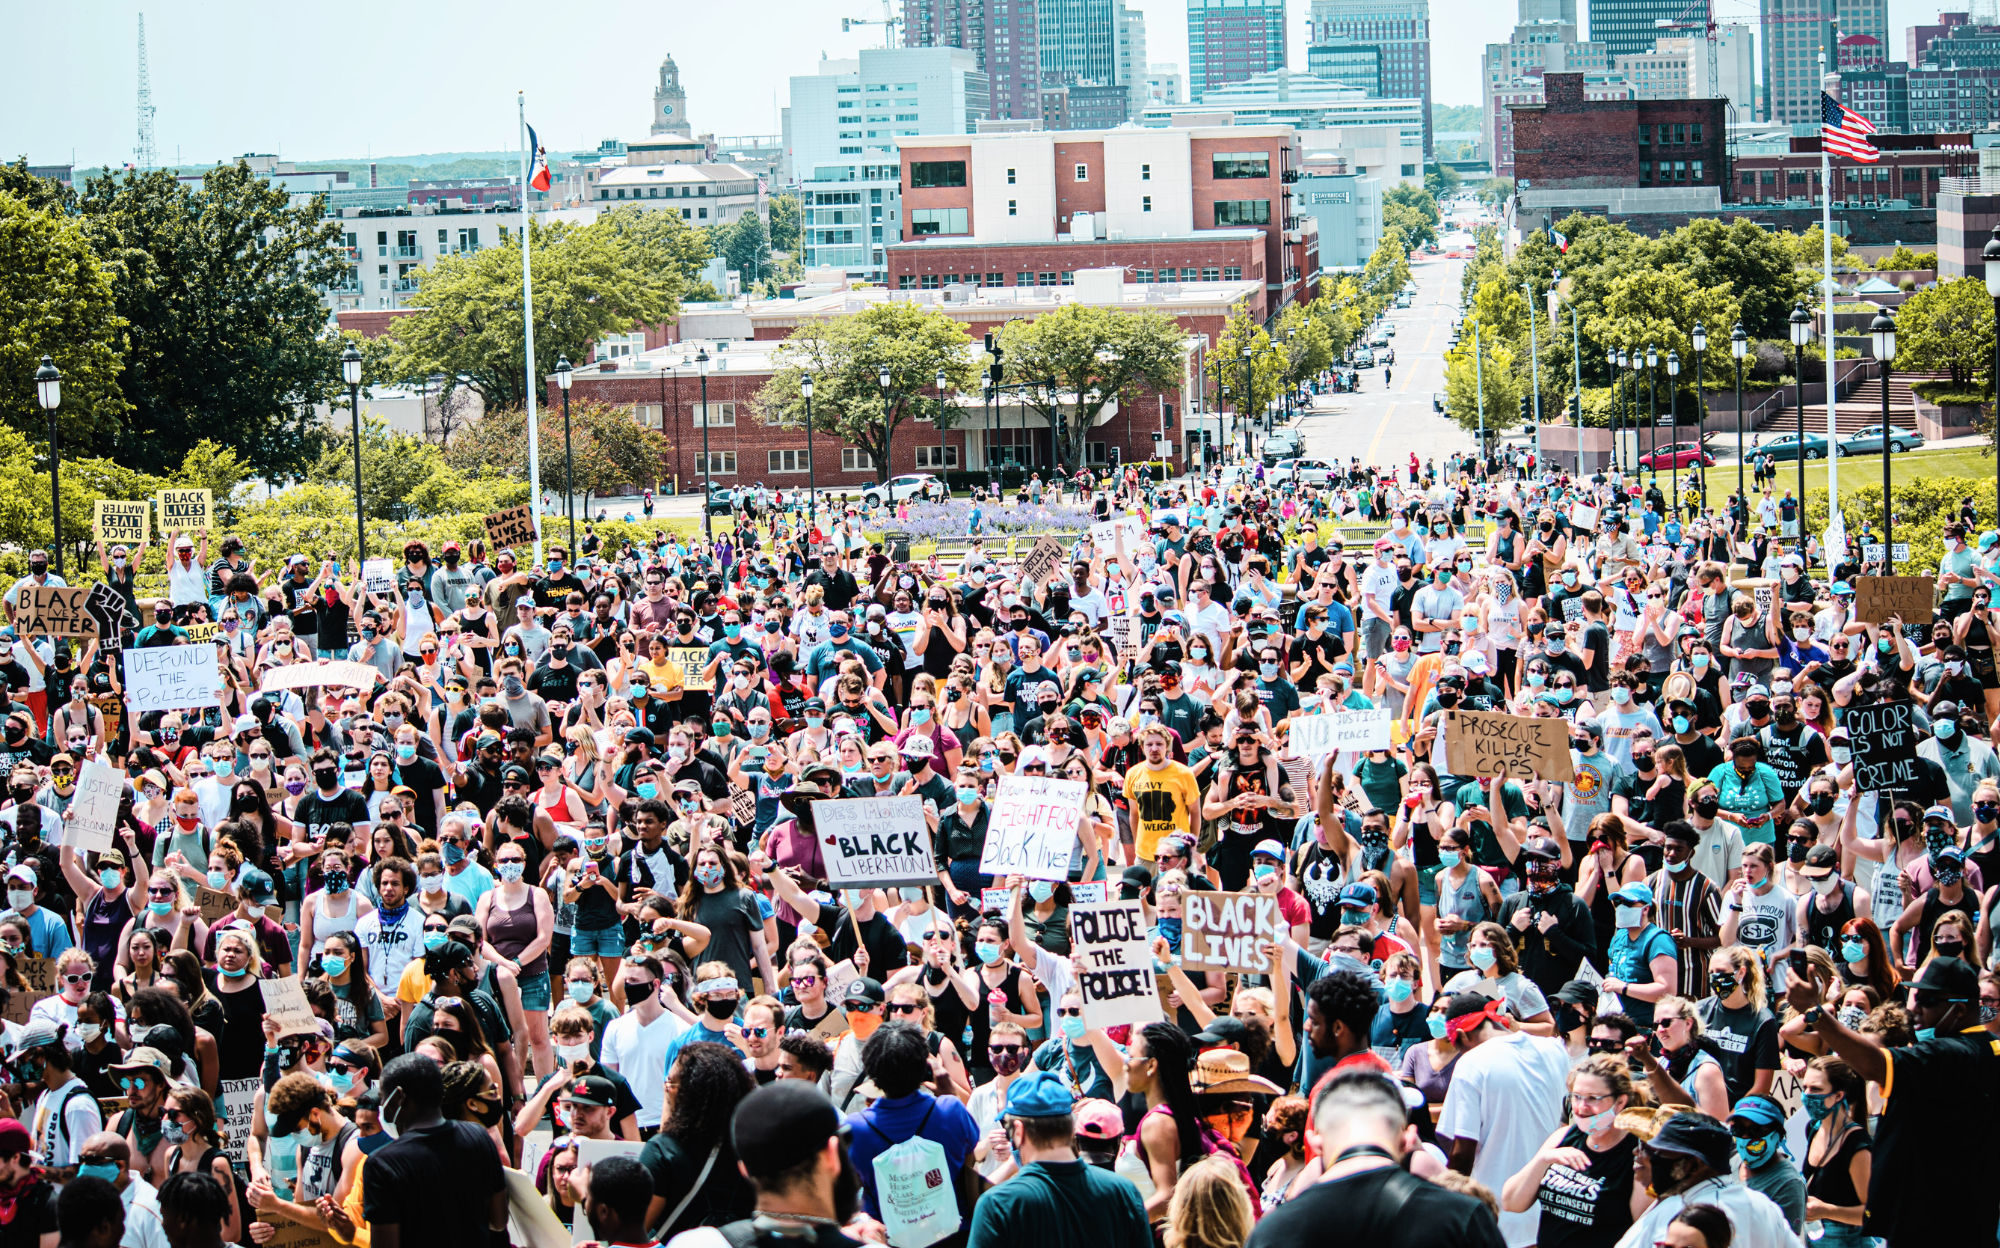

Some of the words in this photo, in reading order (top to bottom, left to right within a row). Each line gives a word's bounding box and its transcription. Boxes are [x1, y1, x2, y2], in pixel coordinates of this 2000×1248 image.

[164, 492, 204, 503] BLACK
[103, 504, 145, 514] MATTER
[165, 504, 205, 516] LIVES
[103, 515, 141, 526] LIVES
[163, 517, 205, 527] MATTER
[485, 509, 526, 529] BLACK
[102, 527, 142, 539] BLACK
[490, 521, 526, 540] LIVES
[1097, 525, 1135, 541] #BM
[493, 531, 538, 549] MATTER
[1880, 545, 1906, 553] JTICE
[1872, 578, 1922, 596] BLACK
[19, 591, 82, 609] BLAC
[1869, 595, 1915, 609] LIVES
[37, 608, 79, 618] LIVES
[1866, 608, 1926, 623] MATTER
[17, 617, 95, 634] MATTER
[188, 626, 217, 639] BLAC
[1113, 619, 1130, 631] BLACK
[133, 648, 209, 673] DEFUND
[671, 651, 707, 662] LACK
[157, 672, 187, 685] THE
[266, 671, 278, 687] I
[138, 687, 209, 706] POLICE
[1847, 704, 1910, 736] COLOR
[1296, 716, 1330, 752] NO
[1336, 710, 1383, 726] JUSTICE
[1338, 729, 1369, 741] PEACE
[1460, 714, 1551, 746] PROSECUTE
[1606, 727, 1632, 736] CYCLO
[1475, 739, 1542, 758] KILLER
[1849, 735, 1871, 755] IS
[1882, 730, 1906, 749] NOT
[1477, 756, 1533, 775] COPS
[1854, 755, 1867, 770] A
[1780, 777, 1807, 788] mond
[1857, 759, 1919, 792] CRIME
[999, 780, 1025, 797] Brown
[1031, 782, 1050, 797] folk
[1057, 789, 1084, 802] must
[1133, 782, 1164, 791] HEAVY
[84, 795, 96, 816] 4
[819, 802, 856, 822] DES
[68, 813, 114, 834] BREONNA
[1000, 802, 1045, 828] FIGHT
[1047, 805, 1078, 830] FOR
[843, 821, 895, 834] DEMANDS
[1144, 822, 1176, 831] WEIGHT
[839, 830, 923, 858] BLACK
[1036, 830, 1069, 868] lives
[837, 856, 933, 877] LIBERATION!
[202, 892, 238, 910] BLAC
[1185, 894, 1274, 936] BLACK
[1760, 905, 1785, 919] PROUD
[1073, 907, 1146, 945] POLICE
[367, 931, 409, 945] DRIP
[1090, 948, 1126, 967] THE
[1185, 932, 1270, 971] LIVES
[1555, 1194, 1596, 1213] CONSENT
[1566, 1211, 1594, 1226] MATTER
